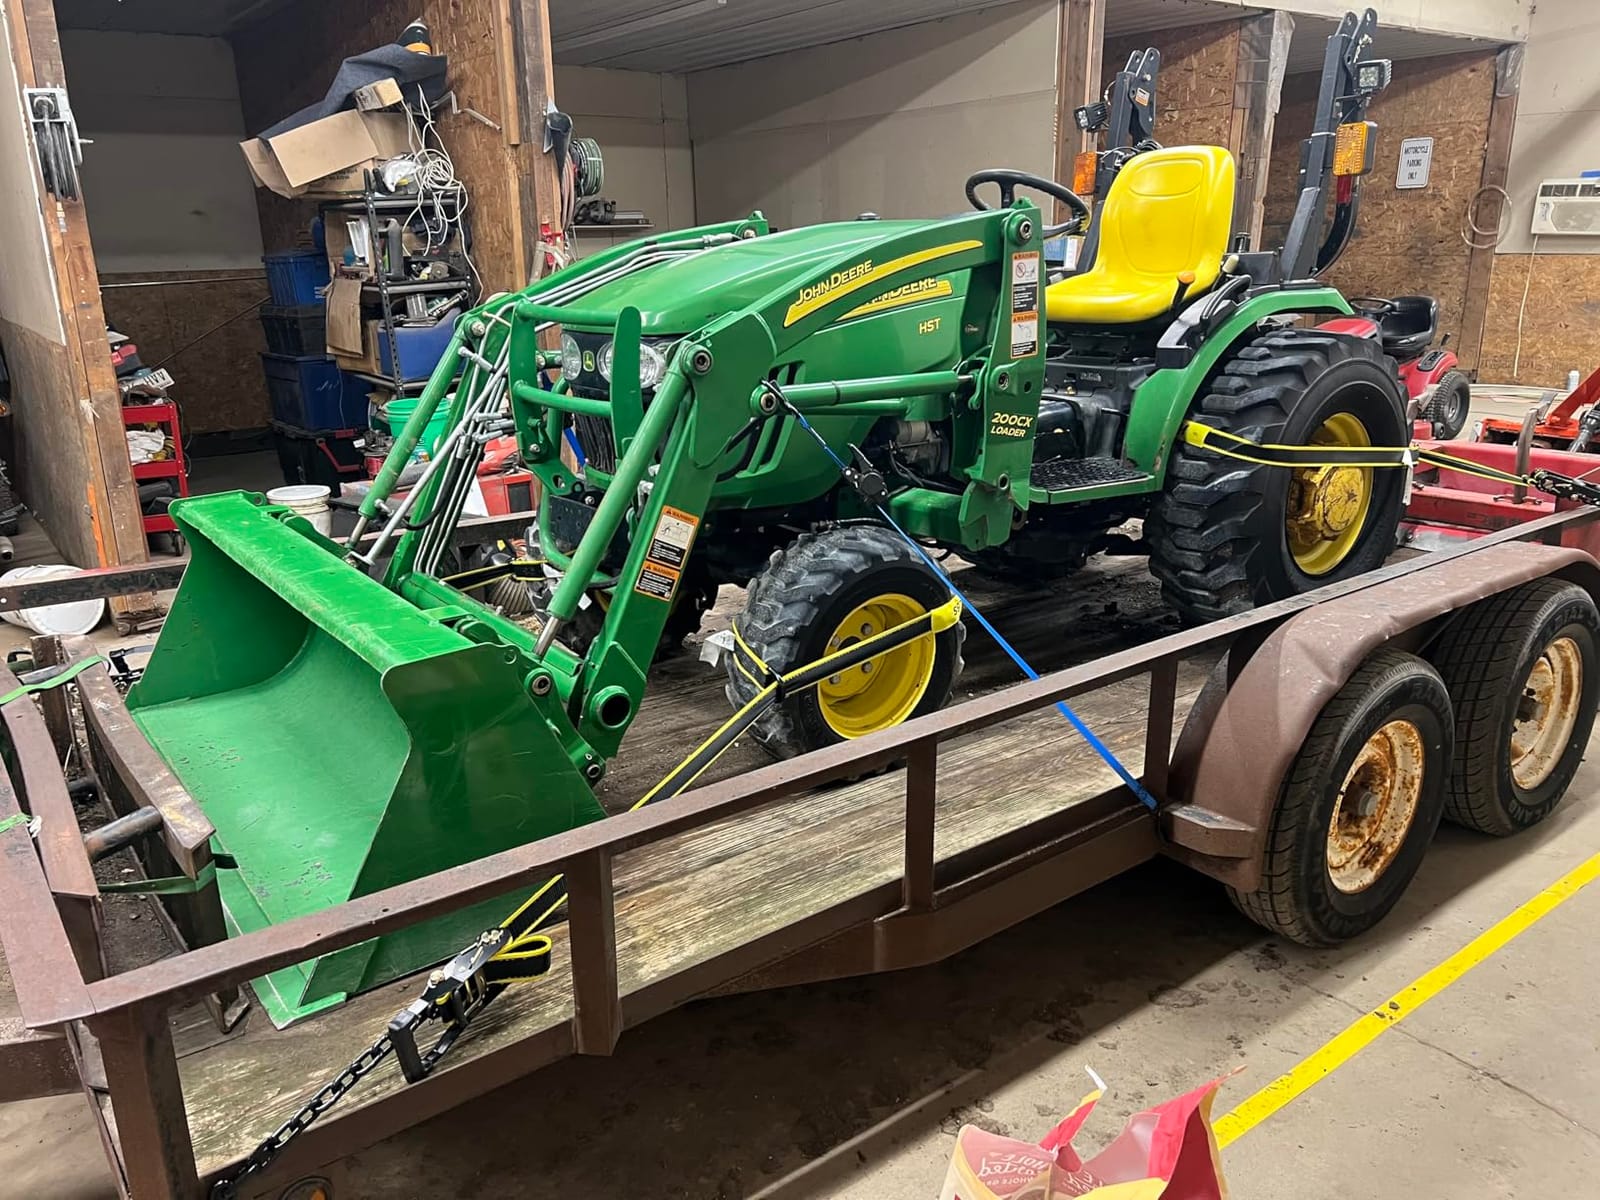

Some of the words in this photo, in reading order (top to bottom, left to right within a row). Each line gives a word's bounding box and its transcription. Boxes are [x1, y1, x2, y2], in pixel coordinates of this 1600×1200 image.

[1404, 146, 1429, 154] MOTORCYCLE
[1407, 159, 1422, 167] PARKING
[1408, 171, 1418, 180] ONLY
[796, 280, 829, 305] JOHN
[831, 260, 873, 288] DEERE
[919, 318, 941, 334] HST
[991, 412, 1034, 428] 200CX
[990, 425, 1026, 438] LOADER
